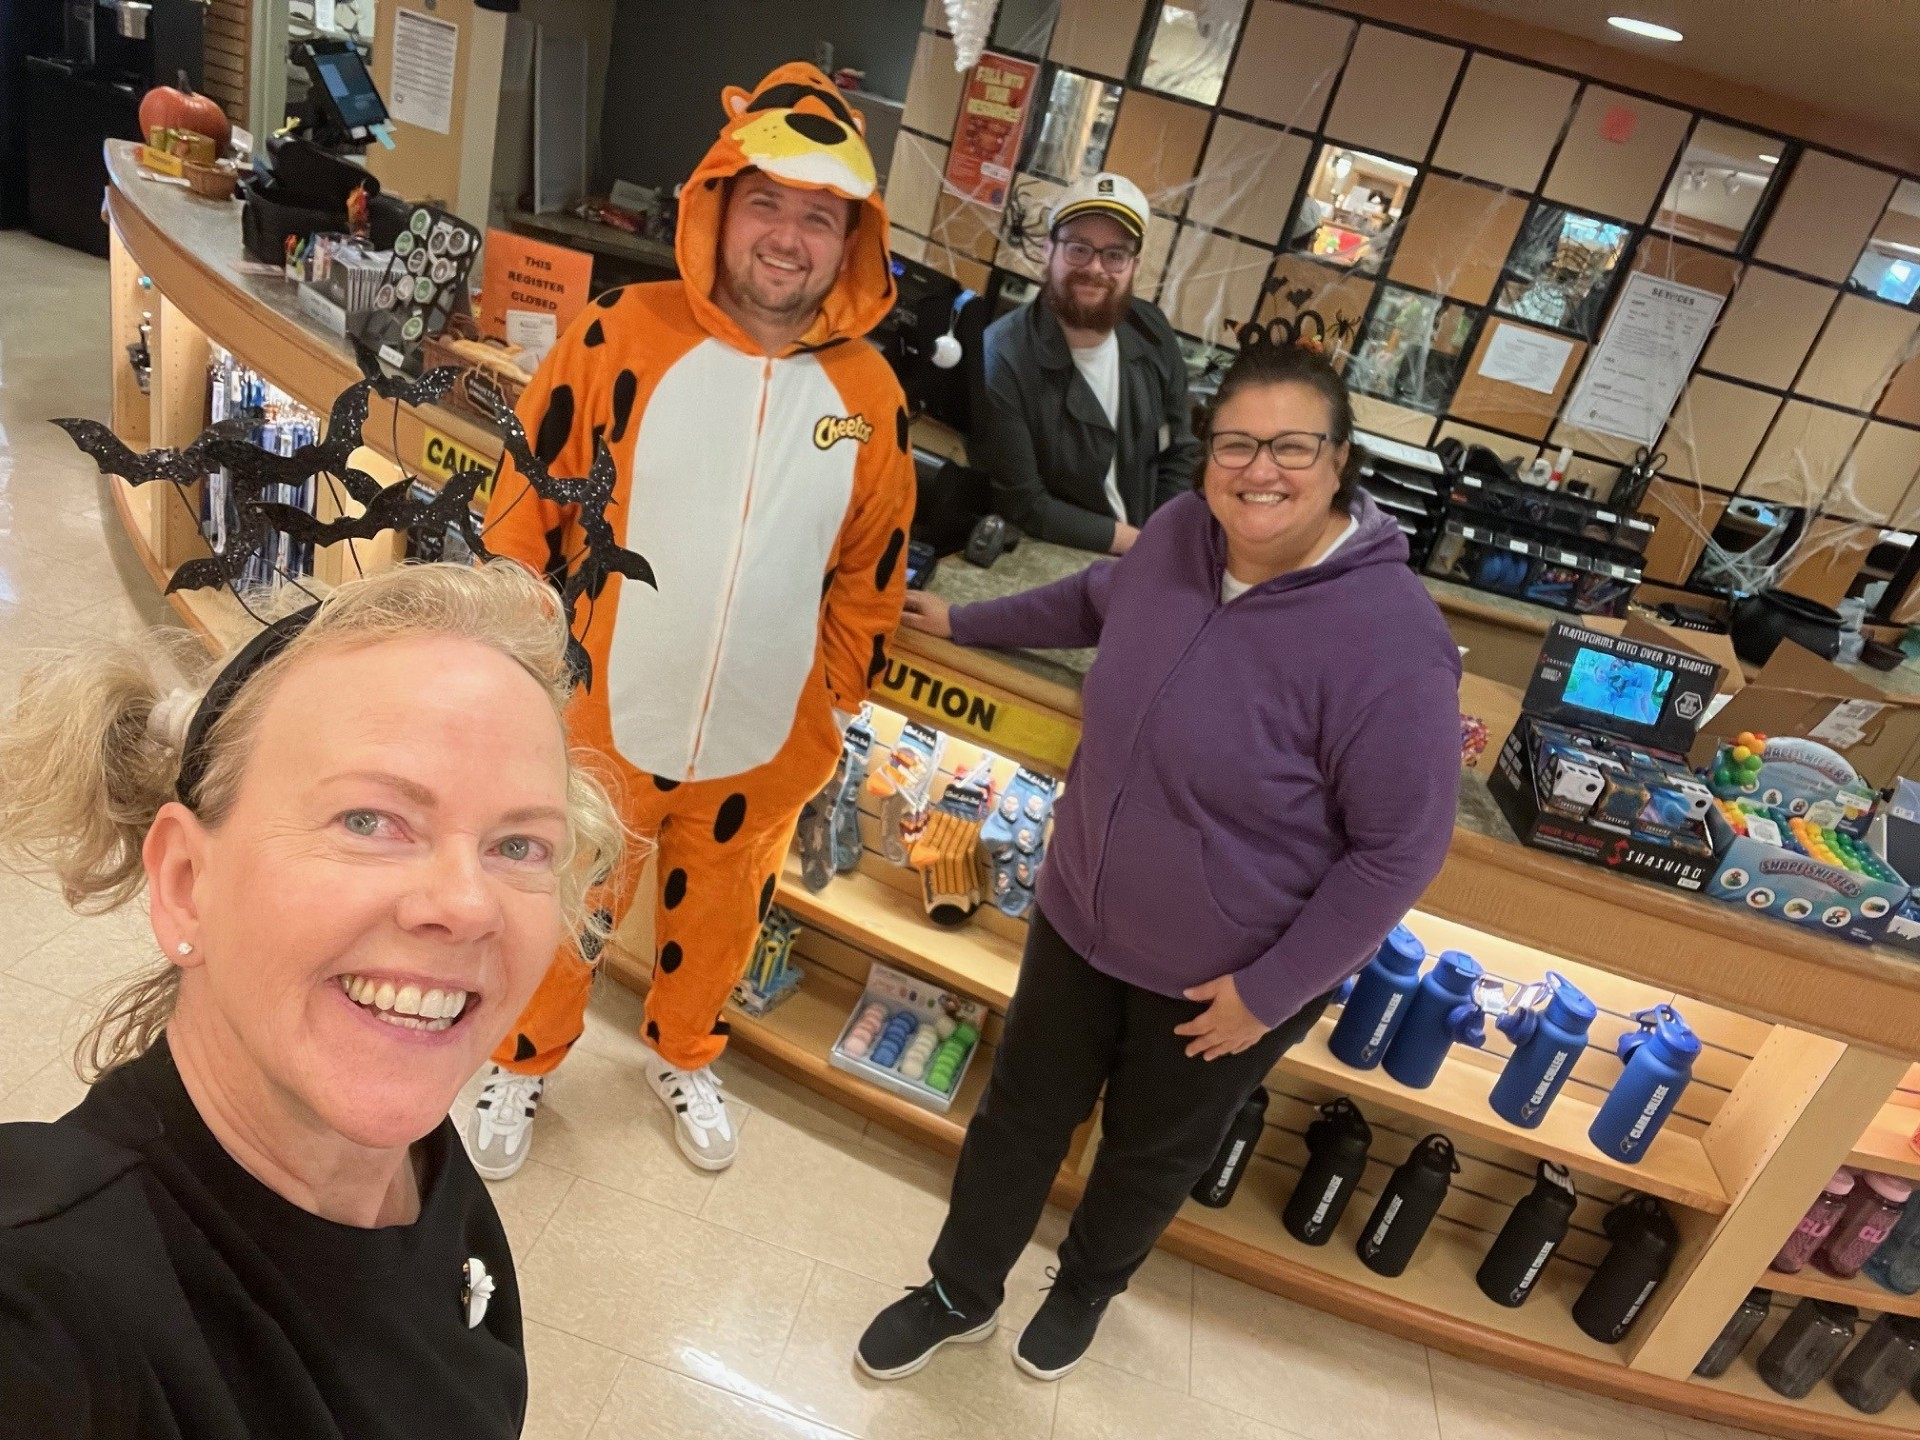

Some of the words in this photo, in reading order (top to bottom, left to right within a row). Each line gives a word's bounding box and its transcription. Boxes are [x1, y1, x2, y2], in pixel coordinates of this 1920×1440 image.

[508, 270, 565, 294] REGISTER
[525, 256, 552, 271] THIS
[511, 291, 558, 310] CLOSED
[1558, 624, 1615, 649] TRANSFORMS
[1616, 640, 1639, 655] INTO
[1640, 647, 1664, 662] OVER
[1677, 657, 1714, 677] SHAPES!
[882, 658, 997, 733] UTION
[1626, 850, 1702, 879] SHASHIBO
[1369, 1022, 1390, 1046] CLARK
[1380, 992, 1404, 1024] COLLEGE
[1530, 1080, 1551, 1105] CLARK
[1543, 1050, 1568, 1082] COLLEGE
[1630, 1113, 1652, 1139] CLARK
[1643, 1084, 1670, 1117] COLLEGE
[1217, 1166, 1233, 1188] CLARK
[1311, 1201, 1330, 1224] CLARK
[1322, 1174, 1344, 1203] COLLEGE
[1519, 1267, 1540, 1289] CLARK
[1532, 1240, 1556, 1269] COLLEGE
